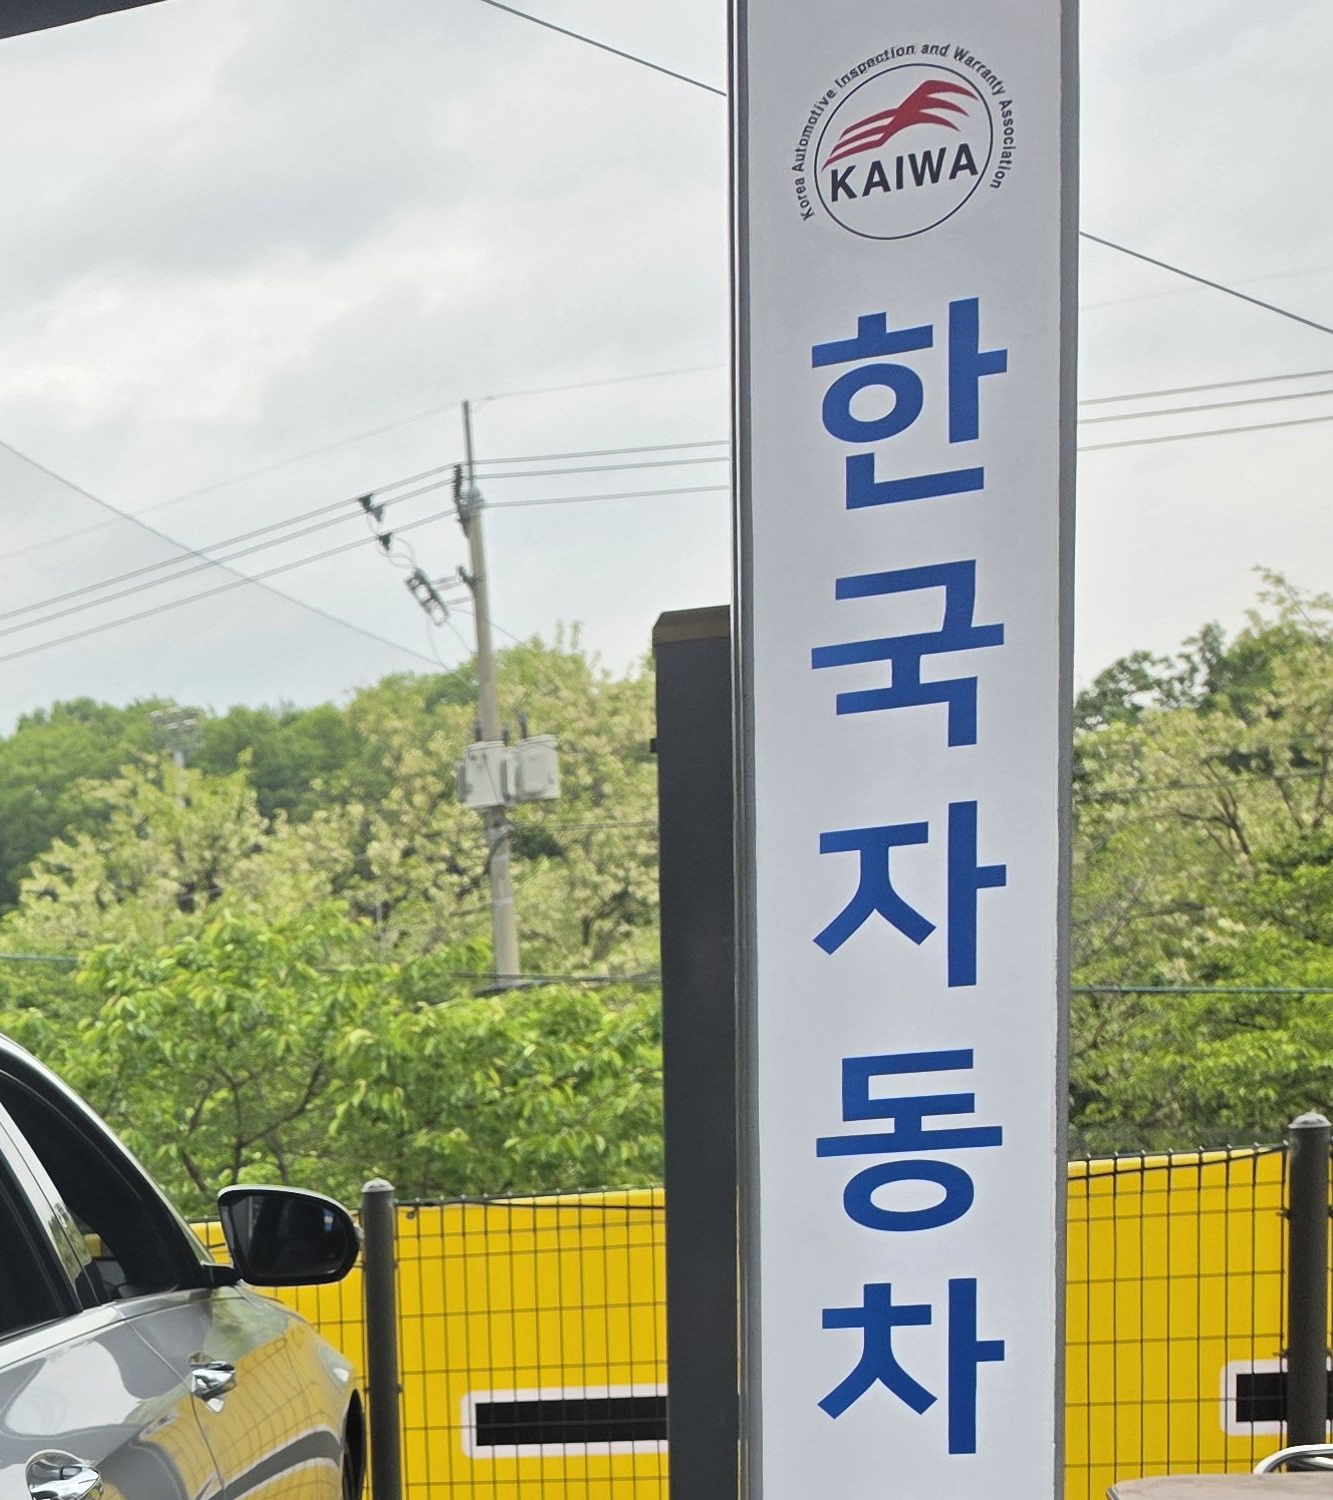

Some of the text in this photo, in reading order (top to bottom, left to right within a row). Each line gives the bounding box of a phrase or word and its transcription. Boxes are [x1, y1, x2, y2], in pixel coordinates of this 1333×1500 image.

[792, 43, 1017, 221] Korea Automotive Inspection and Warranty Association
[831, 142, 979, 203] KAIWA
